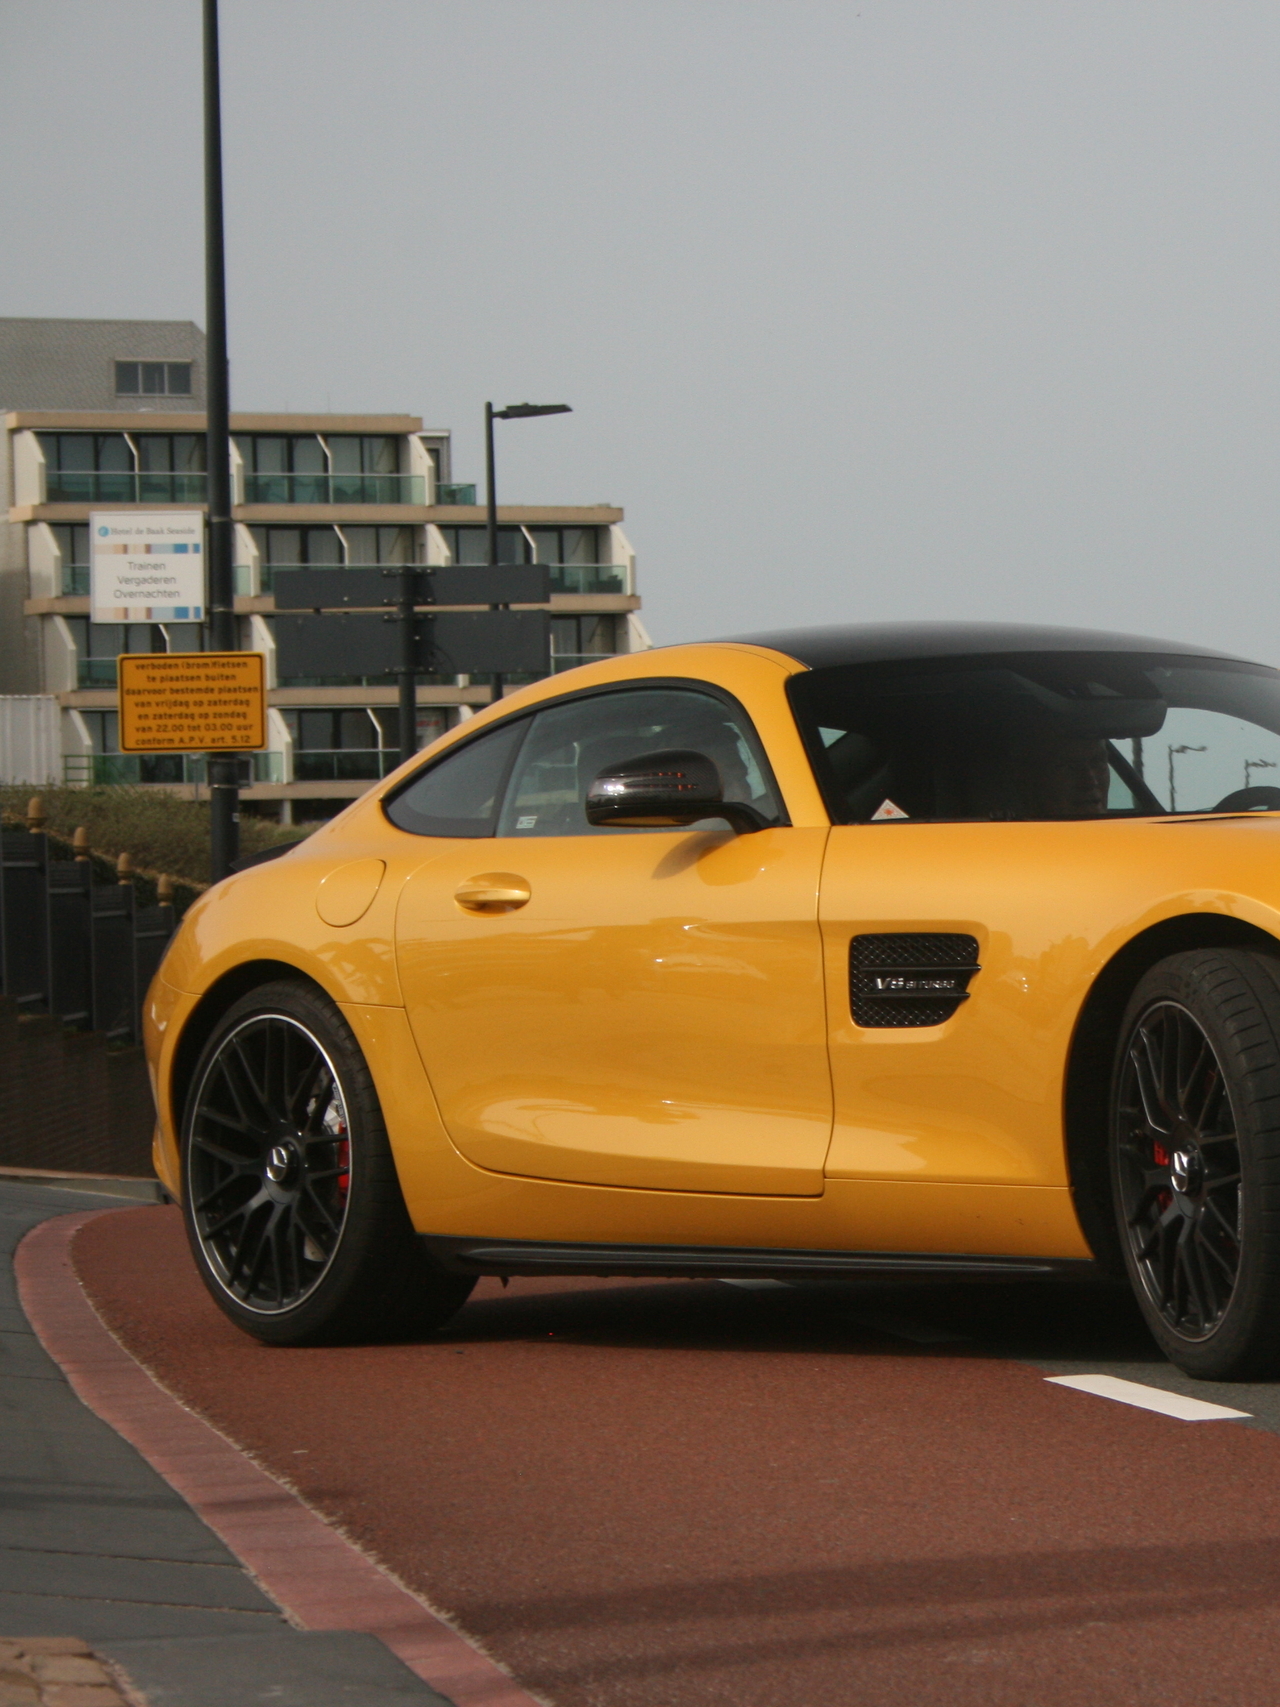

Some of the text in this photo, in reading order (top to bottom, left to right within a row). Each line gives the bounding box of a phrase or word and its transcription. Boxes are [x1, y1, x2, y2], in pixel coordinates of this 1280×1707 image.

[110, 527, 133, 535] Hotel
[134, 527, 144, 535] de
[166, 527, 195, 535] Seaside
[127, 561, 166, 571] Trainen
[117, 576, 177, 587] Vergaderen
[113, 589, 180, 599] Overnachten
[135, 661, 179, 670] verboden
[159, 674, 202, 683] plaatsen
[205, 673, 236, 681] buiten
[125, 685, 259, 695] daarvoor bestemde plaatsen
[155, 699, 190, 710] vrijdag
[193, 700, 204, 708] op
[207, 698, 250, 707] zaterdag
[152, 712, 195, 721] zaterdag
[198, 712, 210, 721] op
[212, 711, 247, 720] zondag
[155, 724, 184, 732] 22.00
[187, 724, 201, 732] tot
[204, 723, 233, 731] 03.00
[236, 723, 253, 731] uur
[135, 737, 174, 746] conform
[211, 736, 228, 744] art.
[231, 735, 251, 743] 5.12
